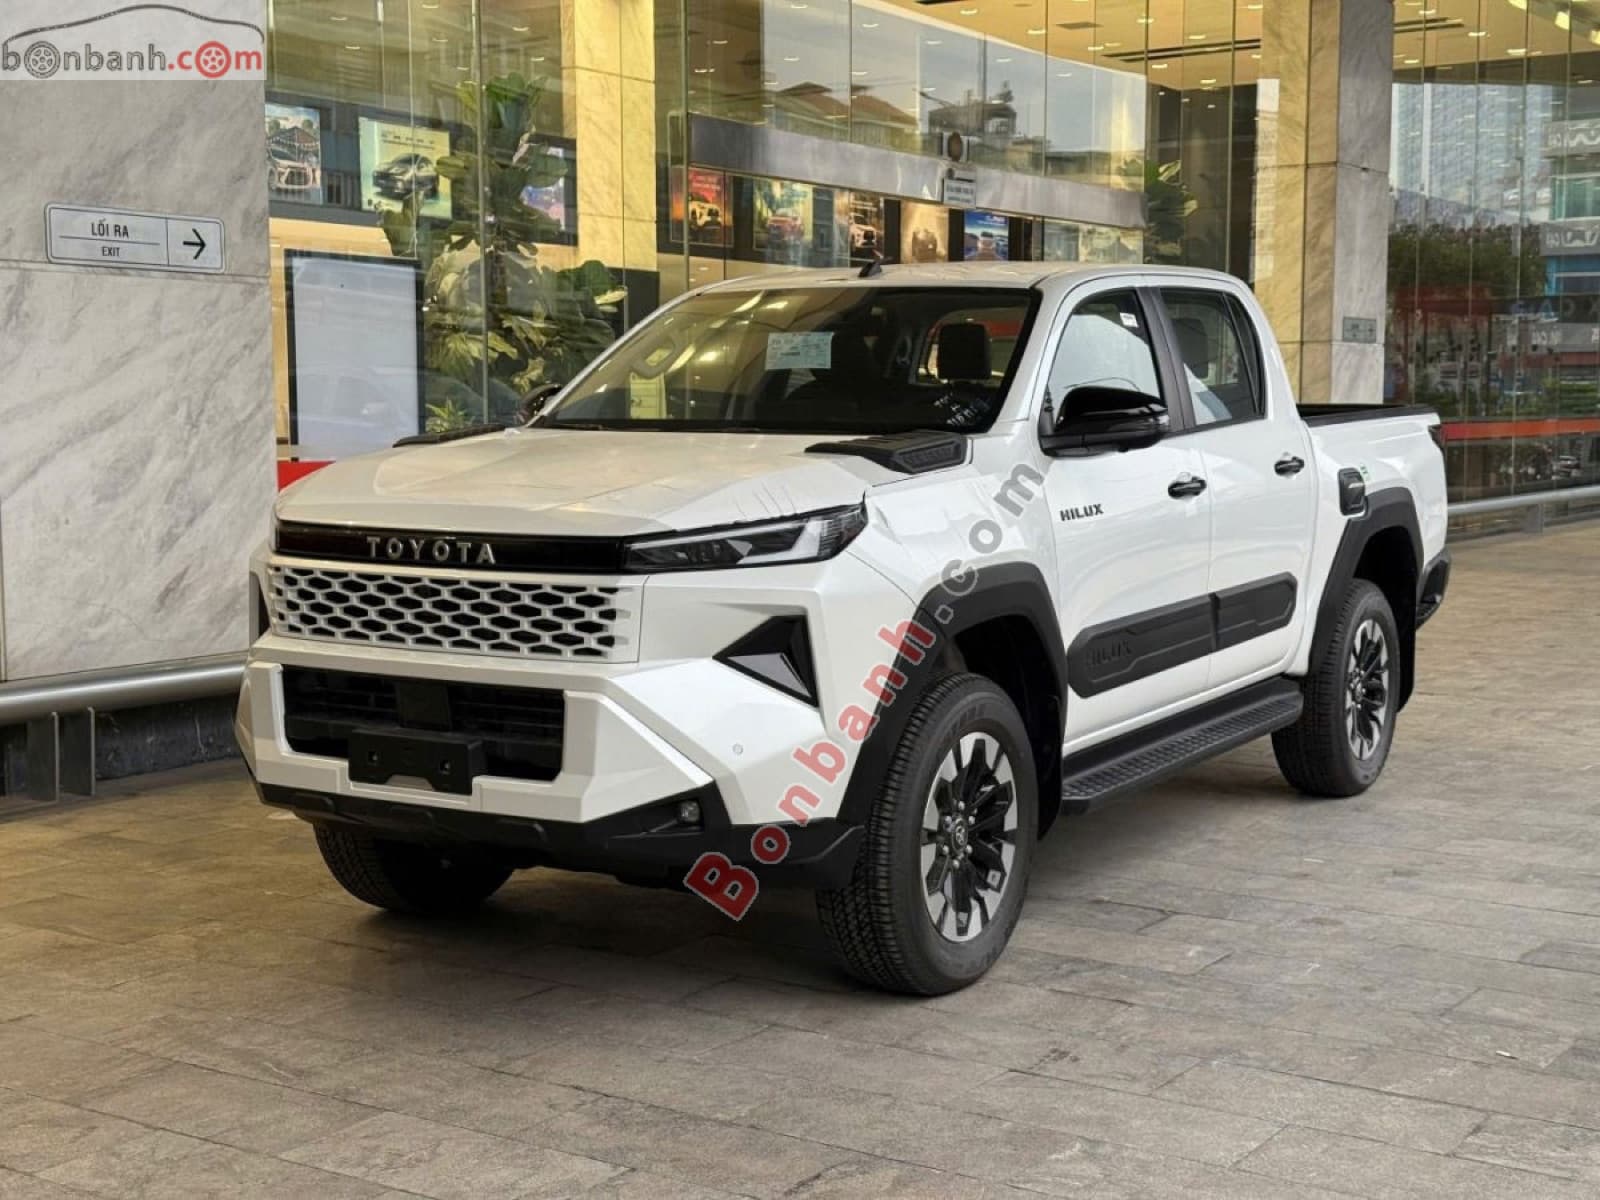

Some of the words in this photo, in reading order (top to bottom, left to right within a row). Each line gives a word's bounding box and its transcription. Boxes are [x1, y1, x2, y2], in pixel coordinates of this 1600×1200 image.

[91, 218, 109, 237] LỐI
[114, 224, 129, 238] RA
[102, 246, 120, 257] EXIT
[1060, 503, 1104, 521] HILUX
[366, 535, 496, 565] TOYOTA
